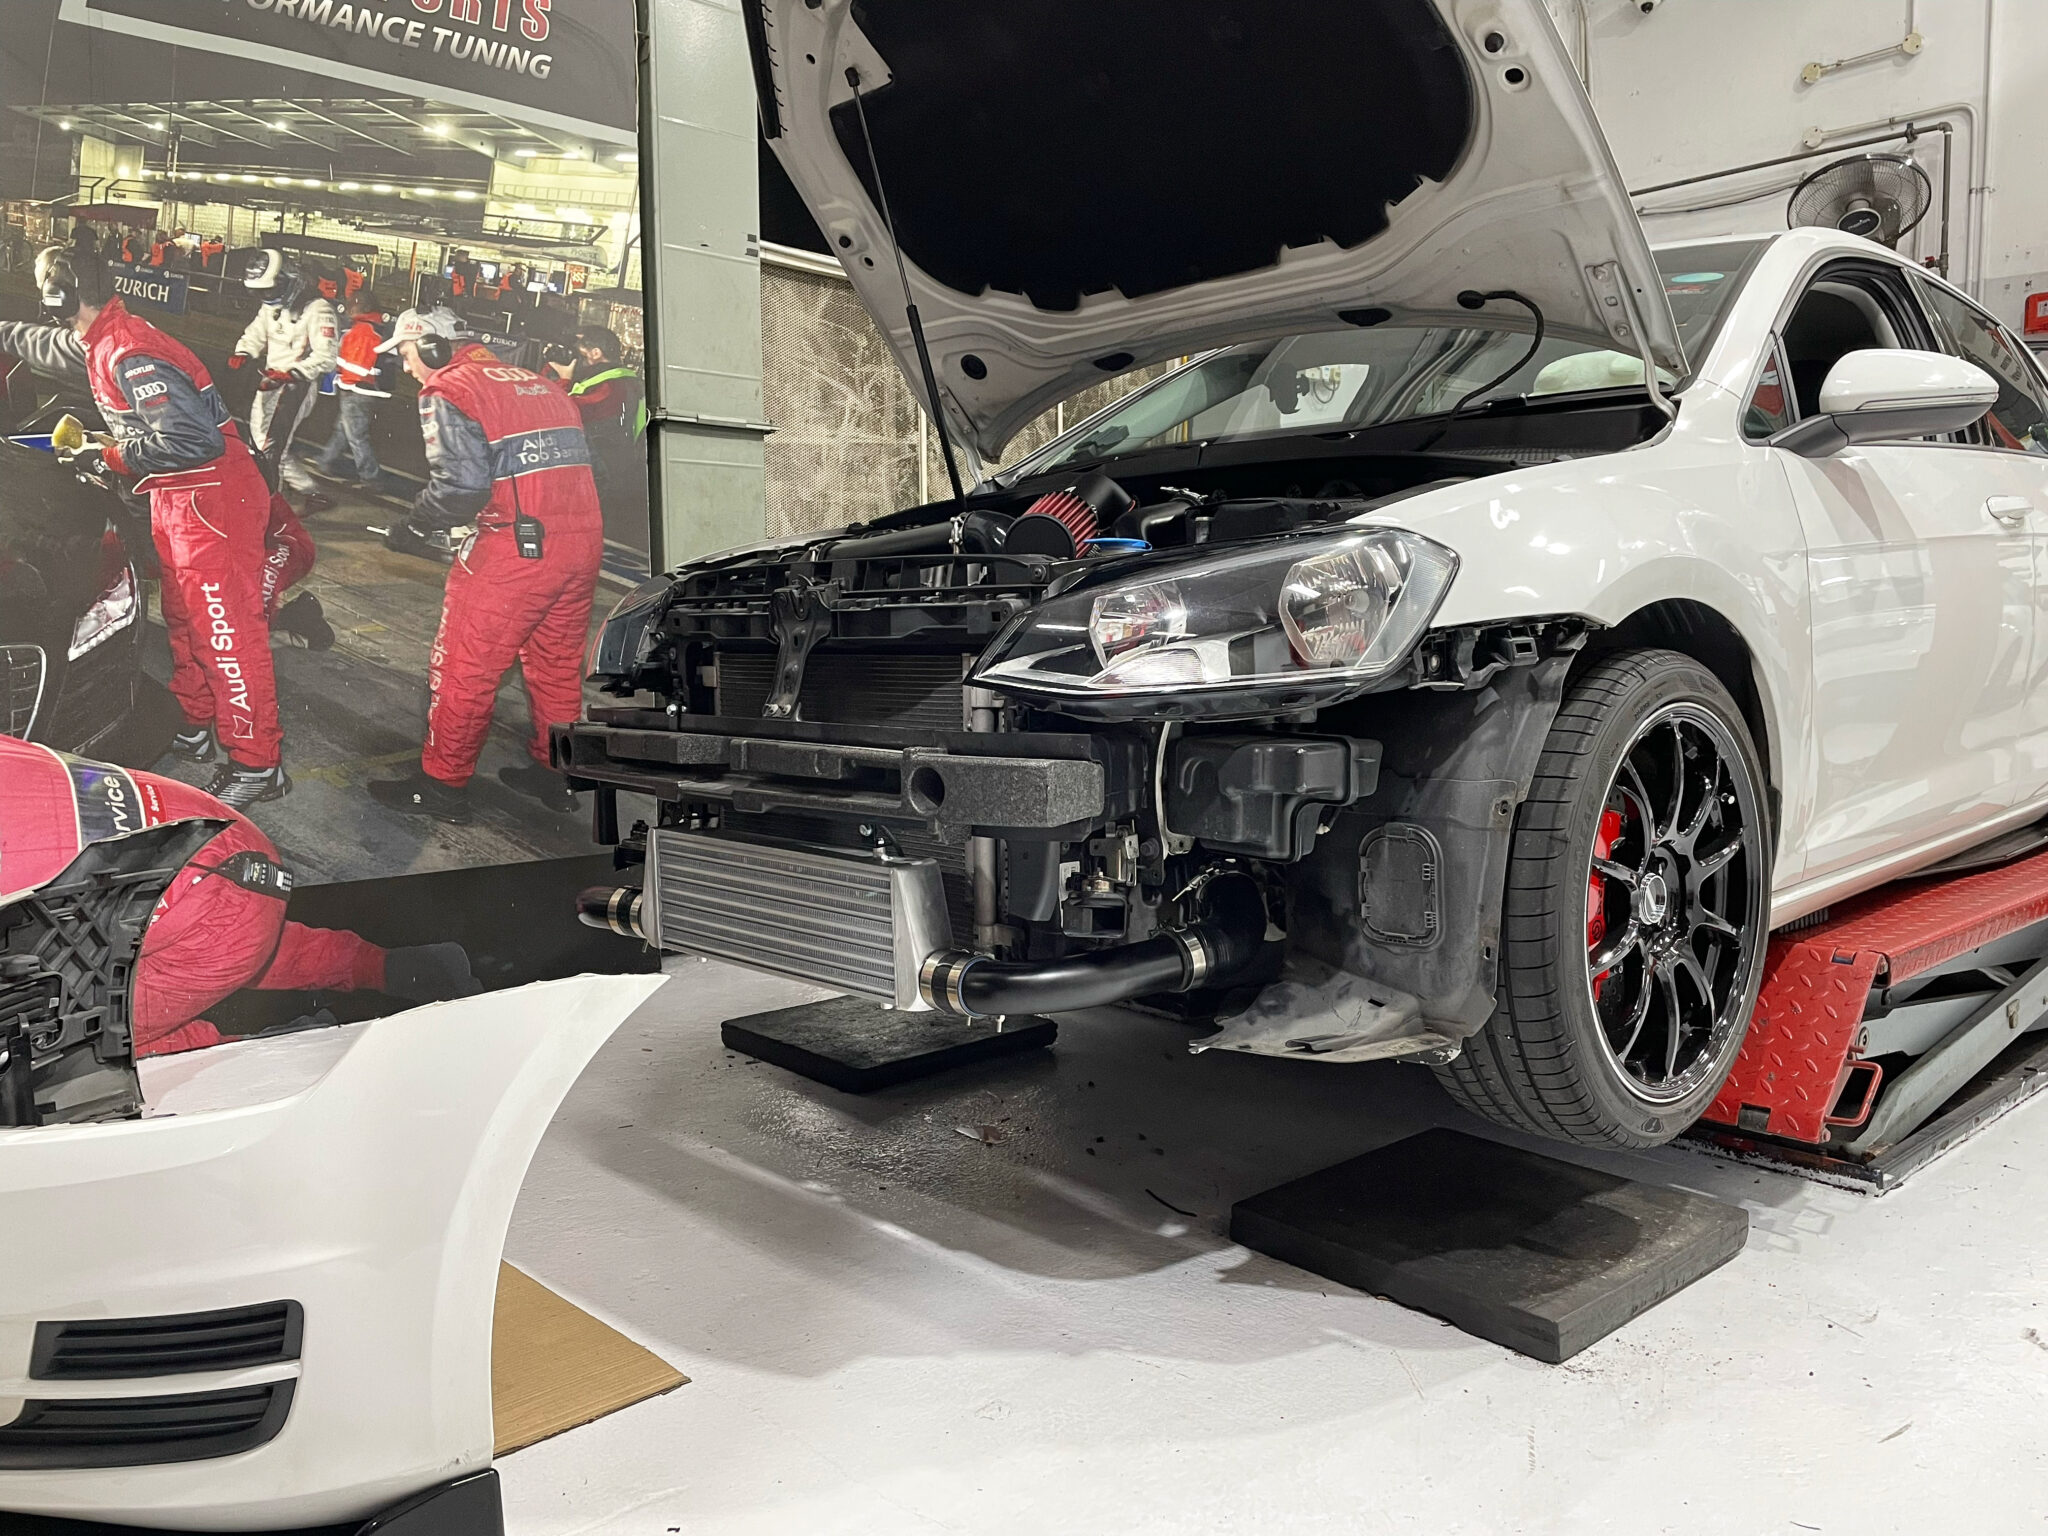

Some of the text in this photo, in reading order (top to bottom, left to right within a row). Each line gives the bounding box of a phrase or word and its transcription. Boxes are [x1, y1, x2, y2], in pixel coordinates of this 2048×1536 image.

[410, 0, 552, 42] RTS
[432, 26, 553, 80] TUNING
[114, 276, 170, 303] ZURICH
[200, 582, 252, 712] Audi Sport
[103, 775, 131, 832] rvice
